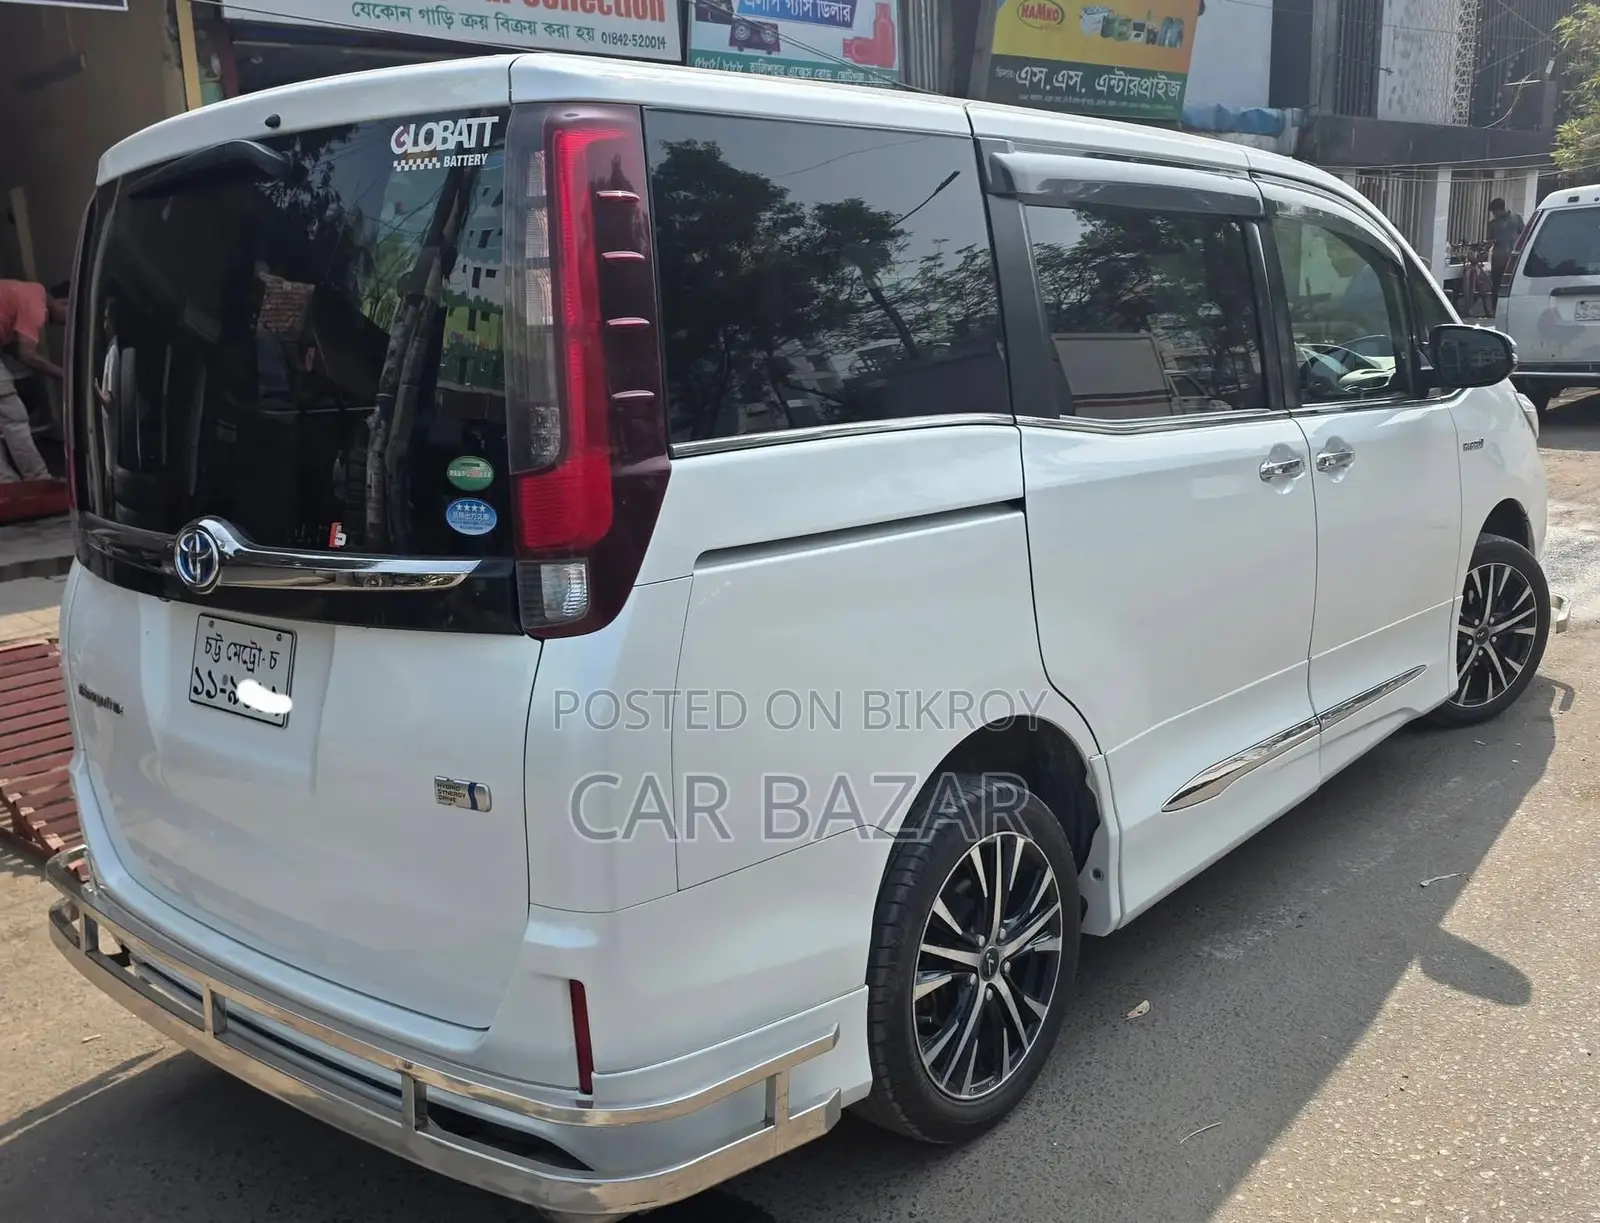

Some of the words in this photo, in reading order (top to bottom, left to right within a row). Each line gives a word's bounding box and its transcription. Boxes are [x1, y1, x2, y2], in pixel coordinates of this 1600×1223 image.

[352, 1, 412, 22] যেকোন
[418, 5, 454, 30] গাড়ি
[459, 12, 489, 31] ক্রয়
[493, 12, 537, 36] বিক্রয়
[541, 21, 570, 39] করা
[573, 25, 595, 42] হয়
[1095, 67, 1182, 100] এন্টারপ্রাইজ
[390, 116, 499, 155] GLOBATT
[443, 153, 488, 168] BATTERY
